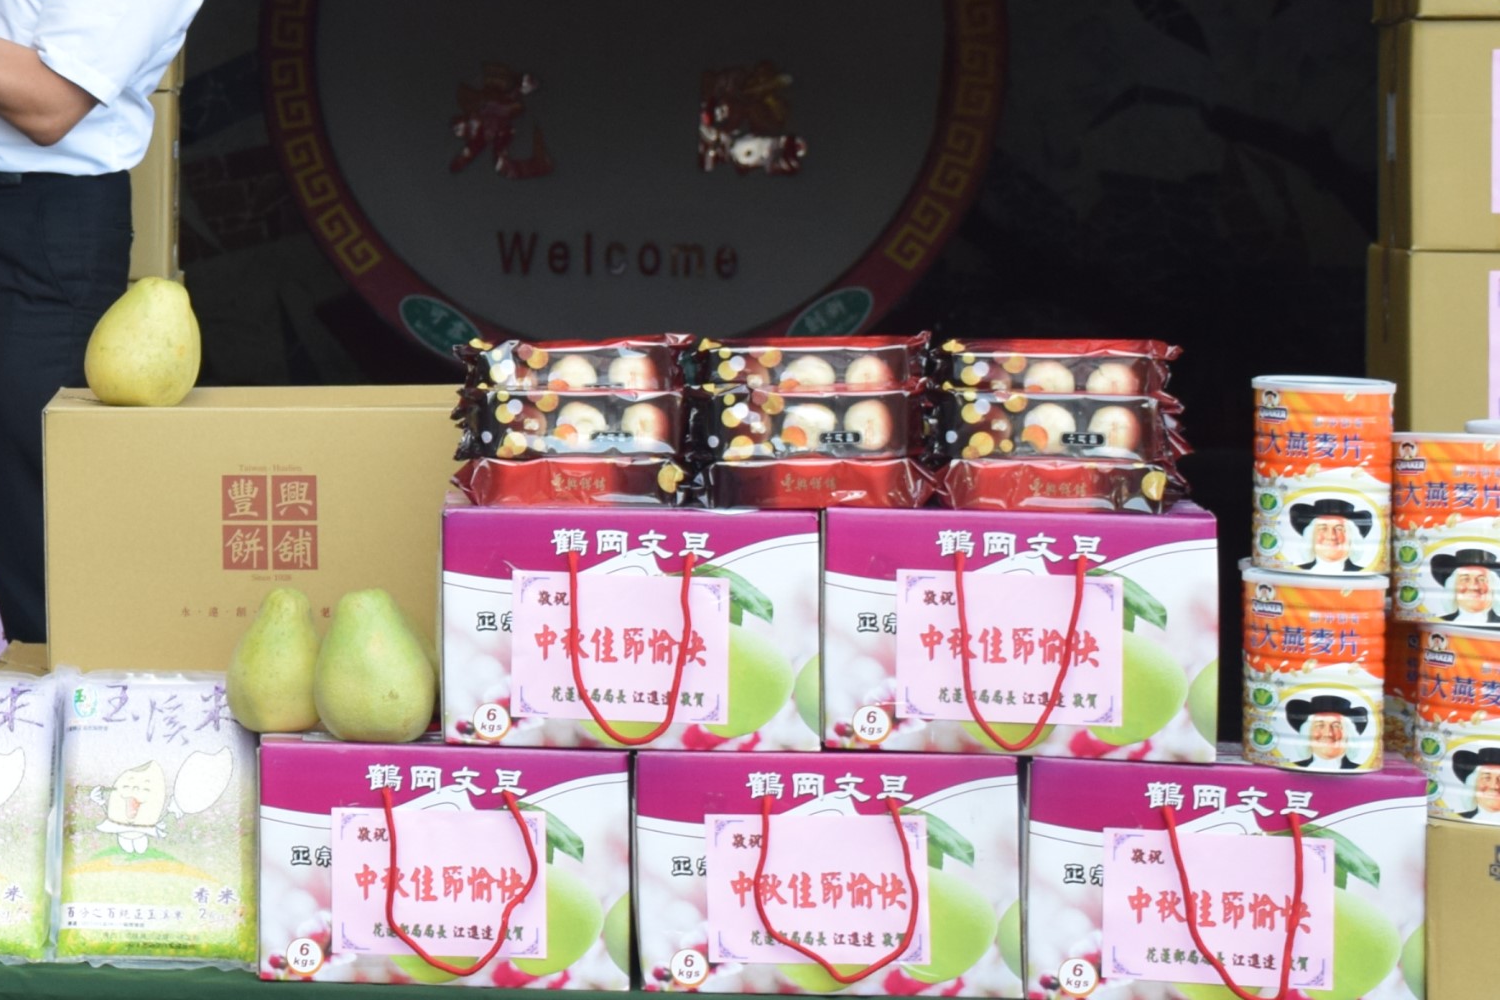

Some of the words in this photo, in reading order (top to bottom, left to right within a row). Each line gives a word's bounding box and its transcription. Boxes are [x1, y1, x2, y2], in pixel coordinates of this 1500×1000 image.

[497, 229, 741, 279] Welcome
[552, 686, 627, 704] 花蓮局局長
[938, 687, 1016, 706] 花蓮局局長
[486, 707, 497, 723] 6
[866, 710, 877, 725] 6
[480, 722, 502, 734] kgs
[860, 725, 882, 736] kgs
[750, 930, 828, 948] 花蓮局局長
[299, 942, 310, 957] 6
[1146, 946, 1226, 968] 花蓮郵局長
[293, 956, 315, 967] kgs
[683, 954, 695, 968] 6
[678, 967, 700, 979] kgs
[1072, 963, 1083, 977] 6
[1065, 977, 1090, 989] kgs
